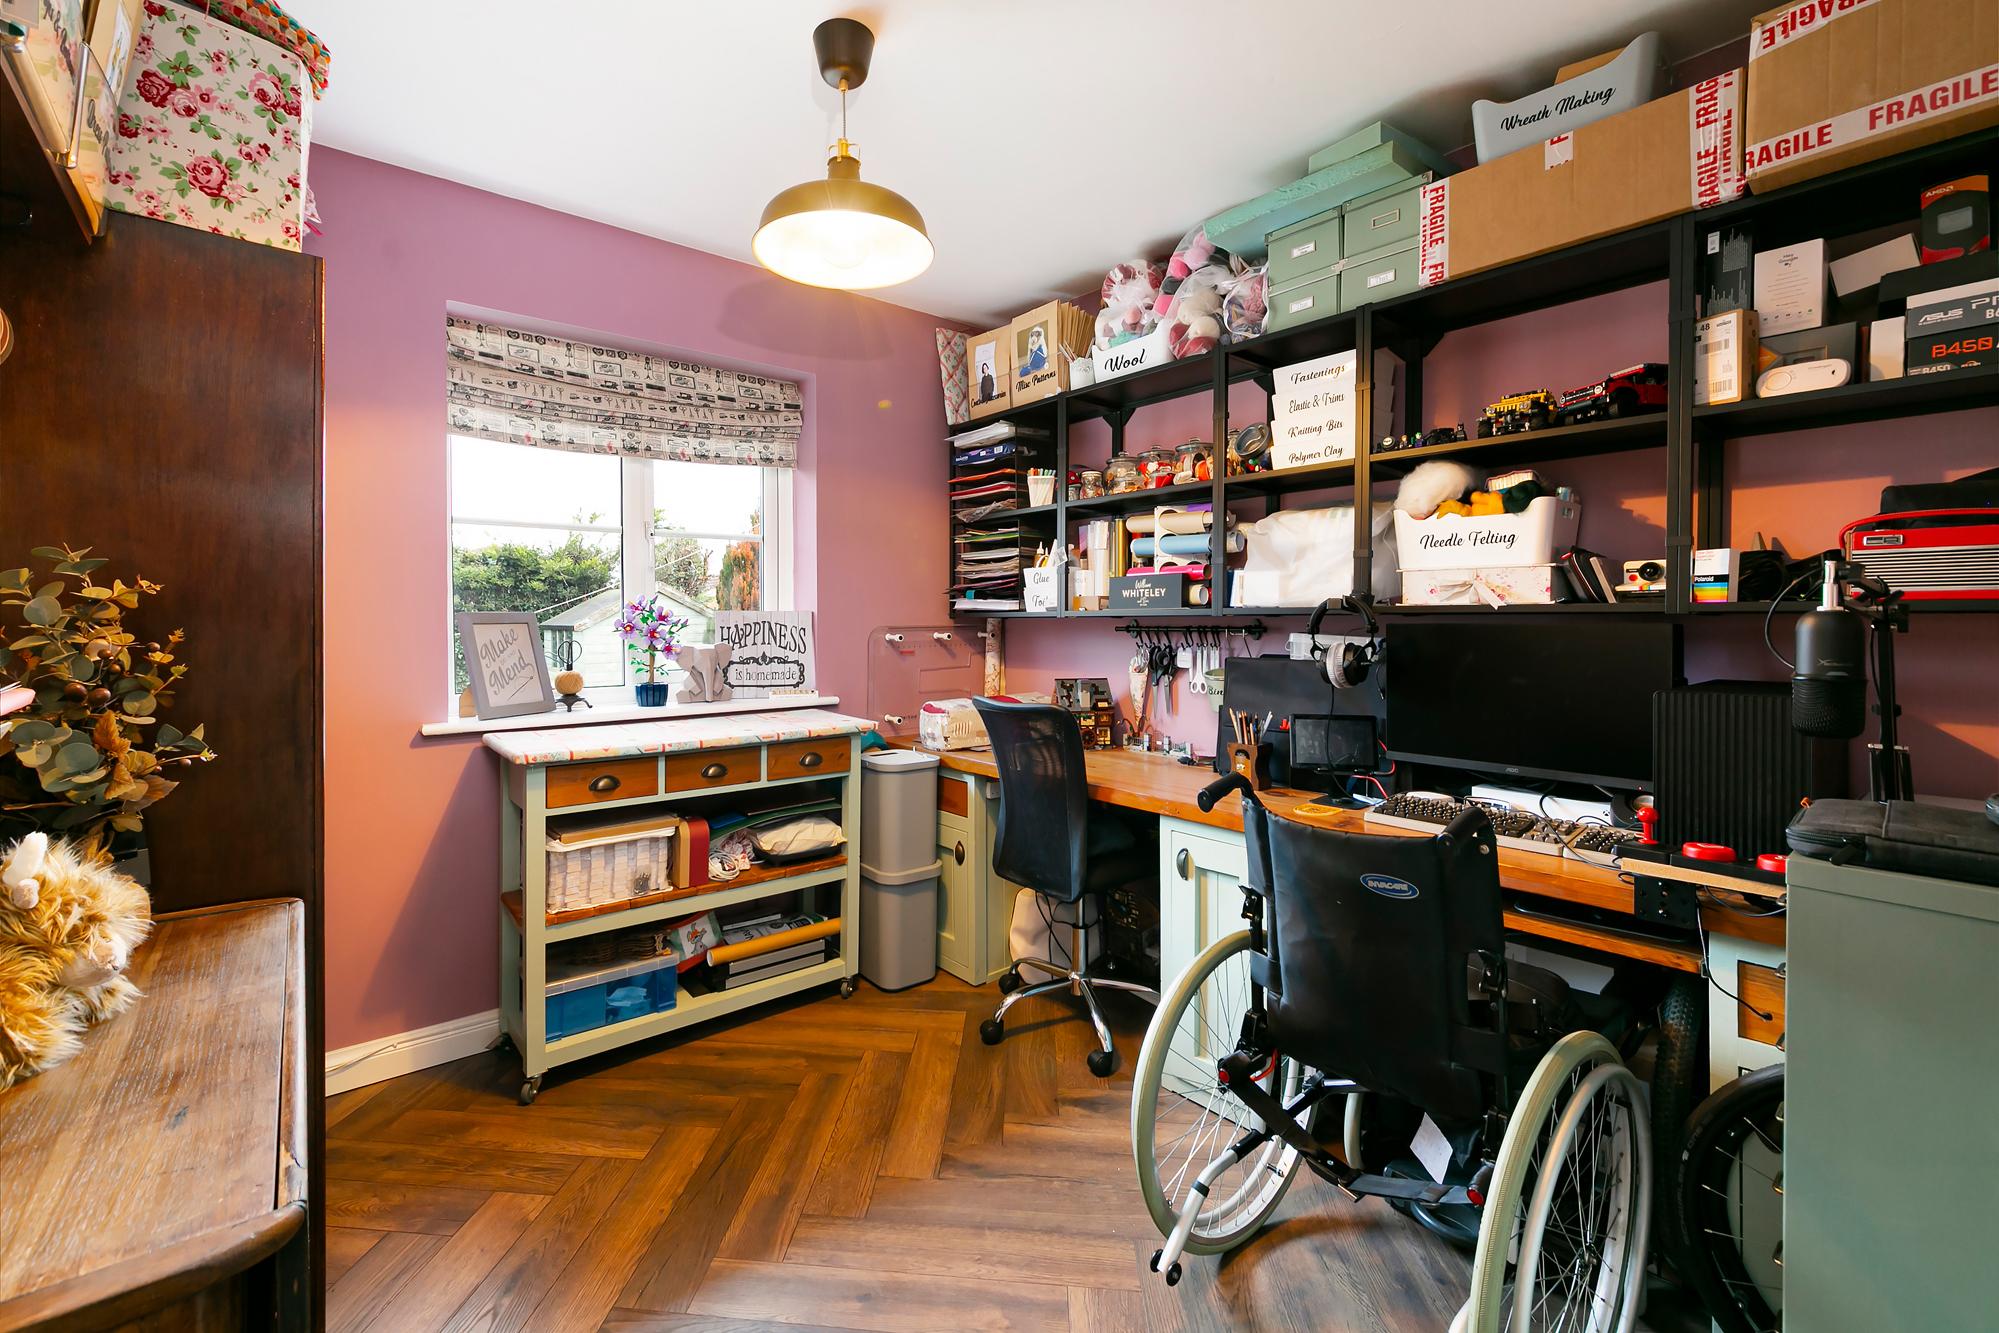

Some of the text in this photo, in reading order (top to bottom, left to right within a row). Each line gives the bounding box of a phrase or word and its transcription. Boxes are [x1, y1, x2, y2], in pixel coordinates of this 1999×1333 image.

[1501, 87, 1616, 131] Wreath Making
[1869, 69, 1999, 131] FRAGILE
[1926, 186, 1953, 198] AMD
[1430, 185, 1445, 248] FRAGILE
[1919, 308, 1963, 323] ASUS
[1931, 337, 1993, 358] B450
[1104, 348, 1148, 372] Wool
[1032, 370, 1056, 386] Patterns
[1290, 364, 1346, 385] Fastenings
[1288, 392, 1345, 414] Elastic & Trims
[1288, 419, 1343, 438] Knitting Bits
[1288, 445, 1343, 464] Polymer Clay
[1419, 530, 1519, 550] Needle Felting
[1033, 572, 1050, 584] Glue
[1122, 588, 1166, 598] WHITELEY
[720, 620, 807, 654] HAPPINESS
[480, 628, 518, 668] Make
[489, 649, 535, 695] Mend
[735, 667, 797, 681] is homemade
[1367, 880, 1409, 891] INVACARE
